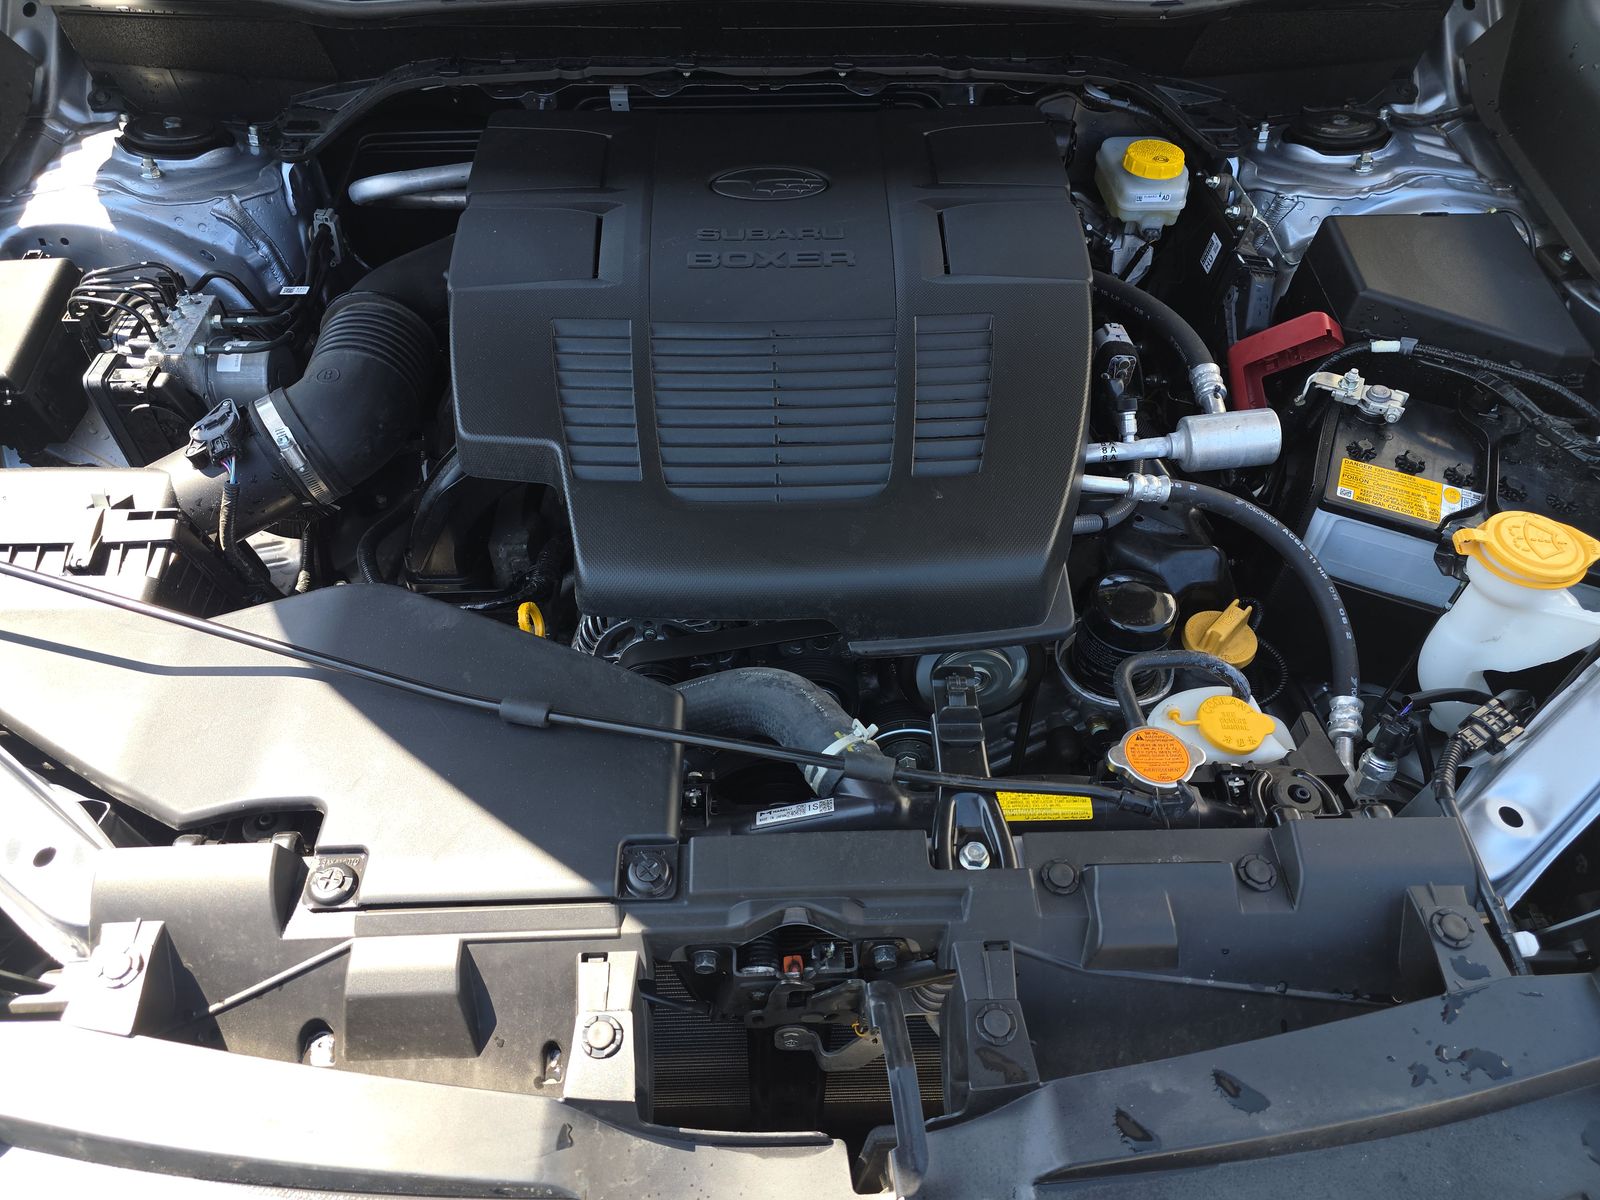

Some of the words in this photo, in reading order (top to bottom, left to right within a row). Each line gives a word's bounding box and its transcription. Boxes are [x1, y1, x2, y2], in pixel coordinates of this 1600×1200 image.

[697, 228, 846, 241] SUBARU
[687, 250, 856, 269] BOXER
[1344, 459, 1372, 470] DANGER
[1341, 472, 1369, 484] POISON
[1244, 503, 1279, 527] YOKOHAMA
